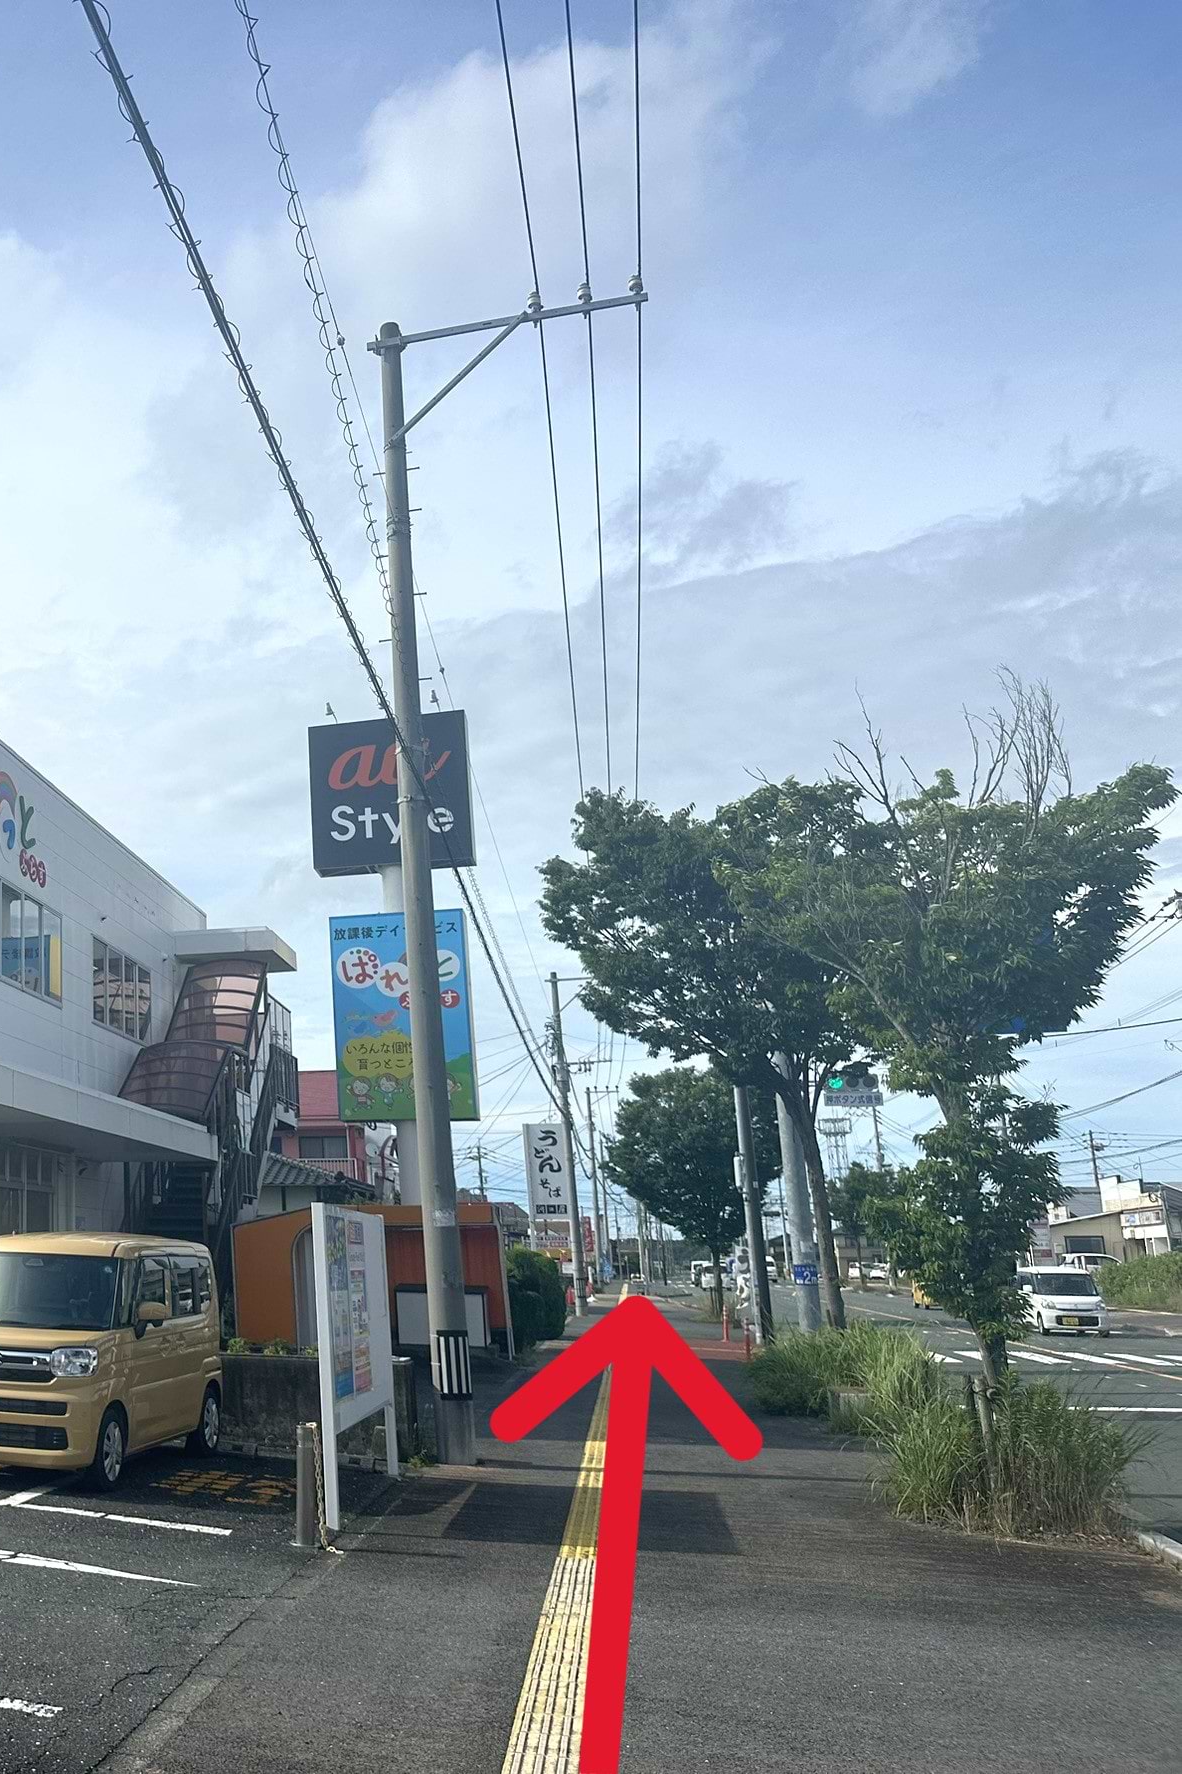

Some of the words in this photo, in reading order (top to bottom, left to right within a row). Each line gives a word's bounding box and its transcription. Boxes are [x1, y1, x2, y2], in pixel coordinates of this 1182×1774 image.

[330, 805, 454, 844] Stye
[533, 1129, 562, 1174] うどん
[539, 1178, 562, 1198] そば
